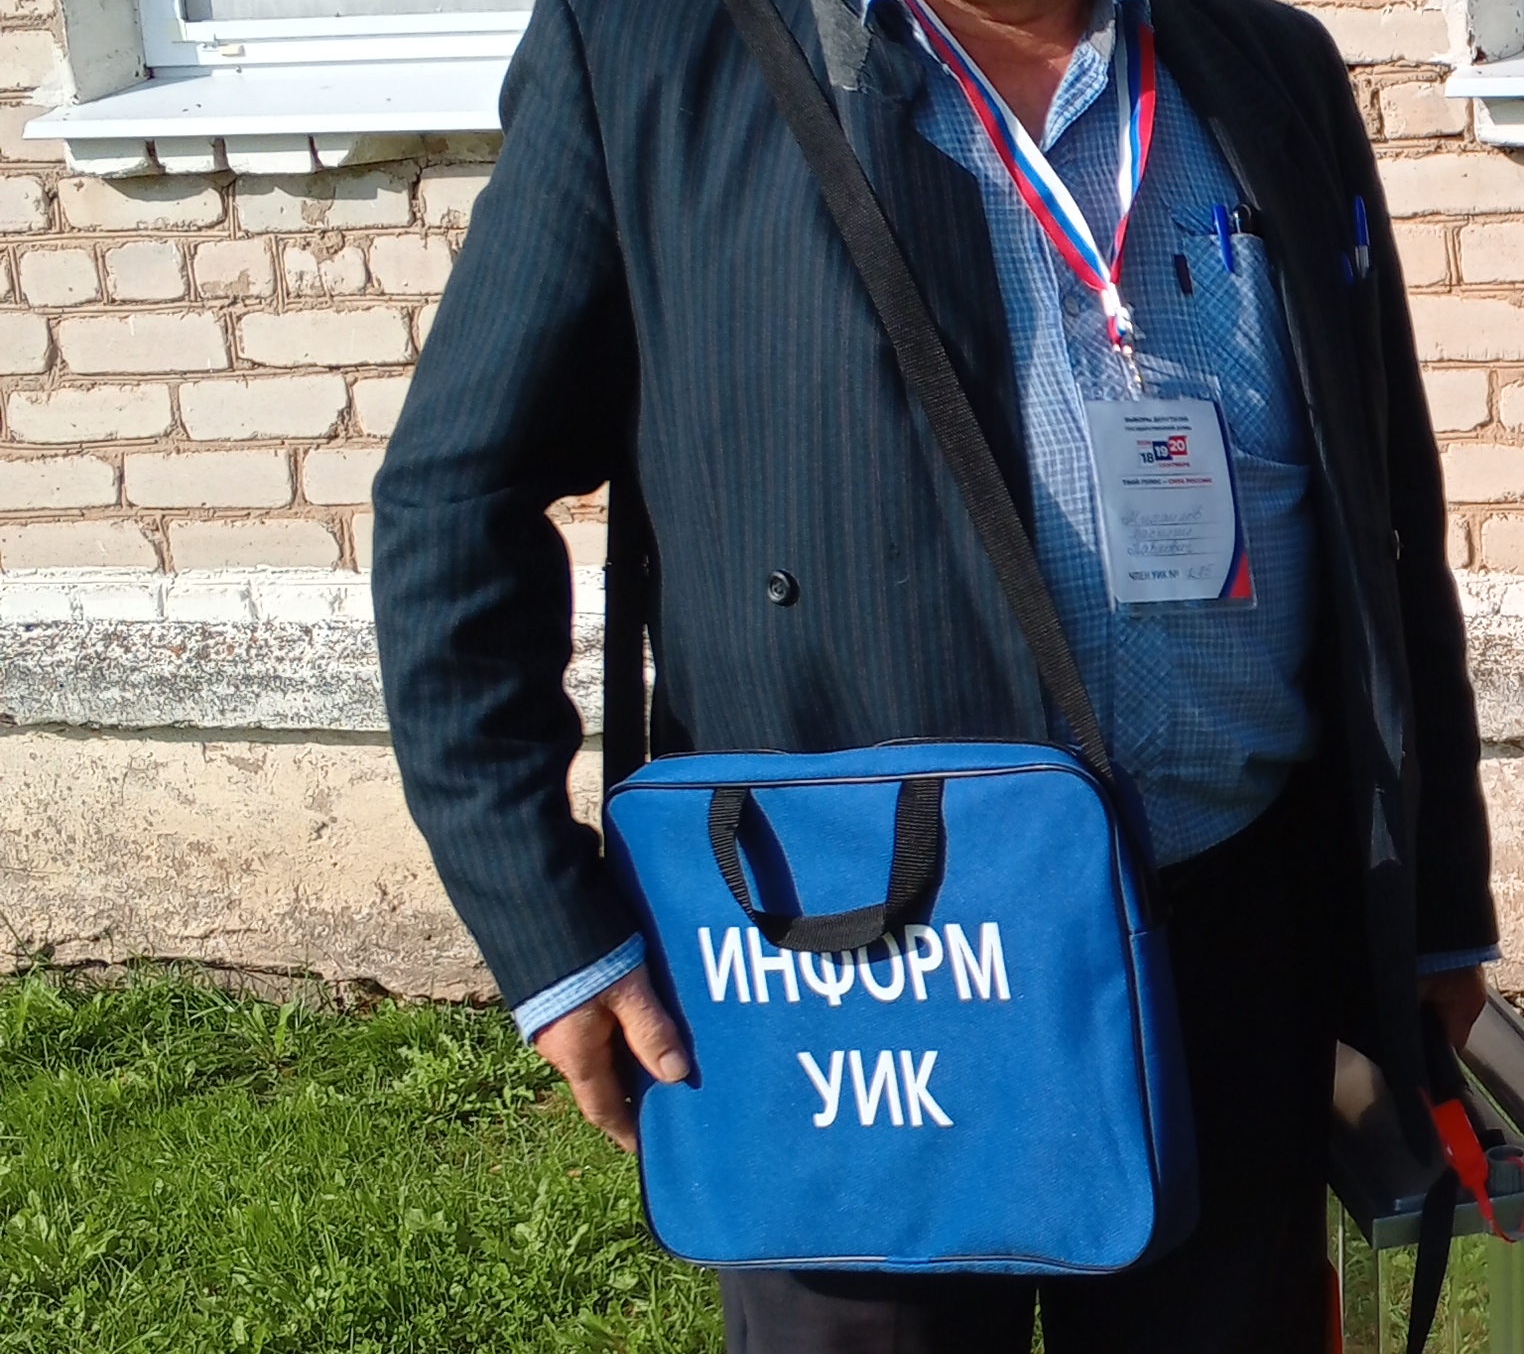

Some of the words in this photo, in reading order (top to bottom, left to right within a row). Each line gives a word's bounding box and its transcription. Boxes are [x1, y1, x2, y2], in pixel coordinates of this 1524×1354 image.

[1139, 453, 1154, 463] 18
[1155, 446, 1168, 457] 19
[1169, 440, 1185, 452] 20
[1129, 572, 1151, 580] ЧЛЕН
[1151, 571, 1167, 579] УИК
[697, 921, 1012, 1008] ИНФОРМ
[797, 1049, 956, 1128] УИК
